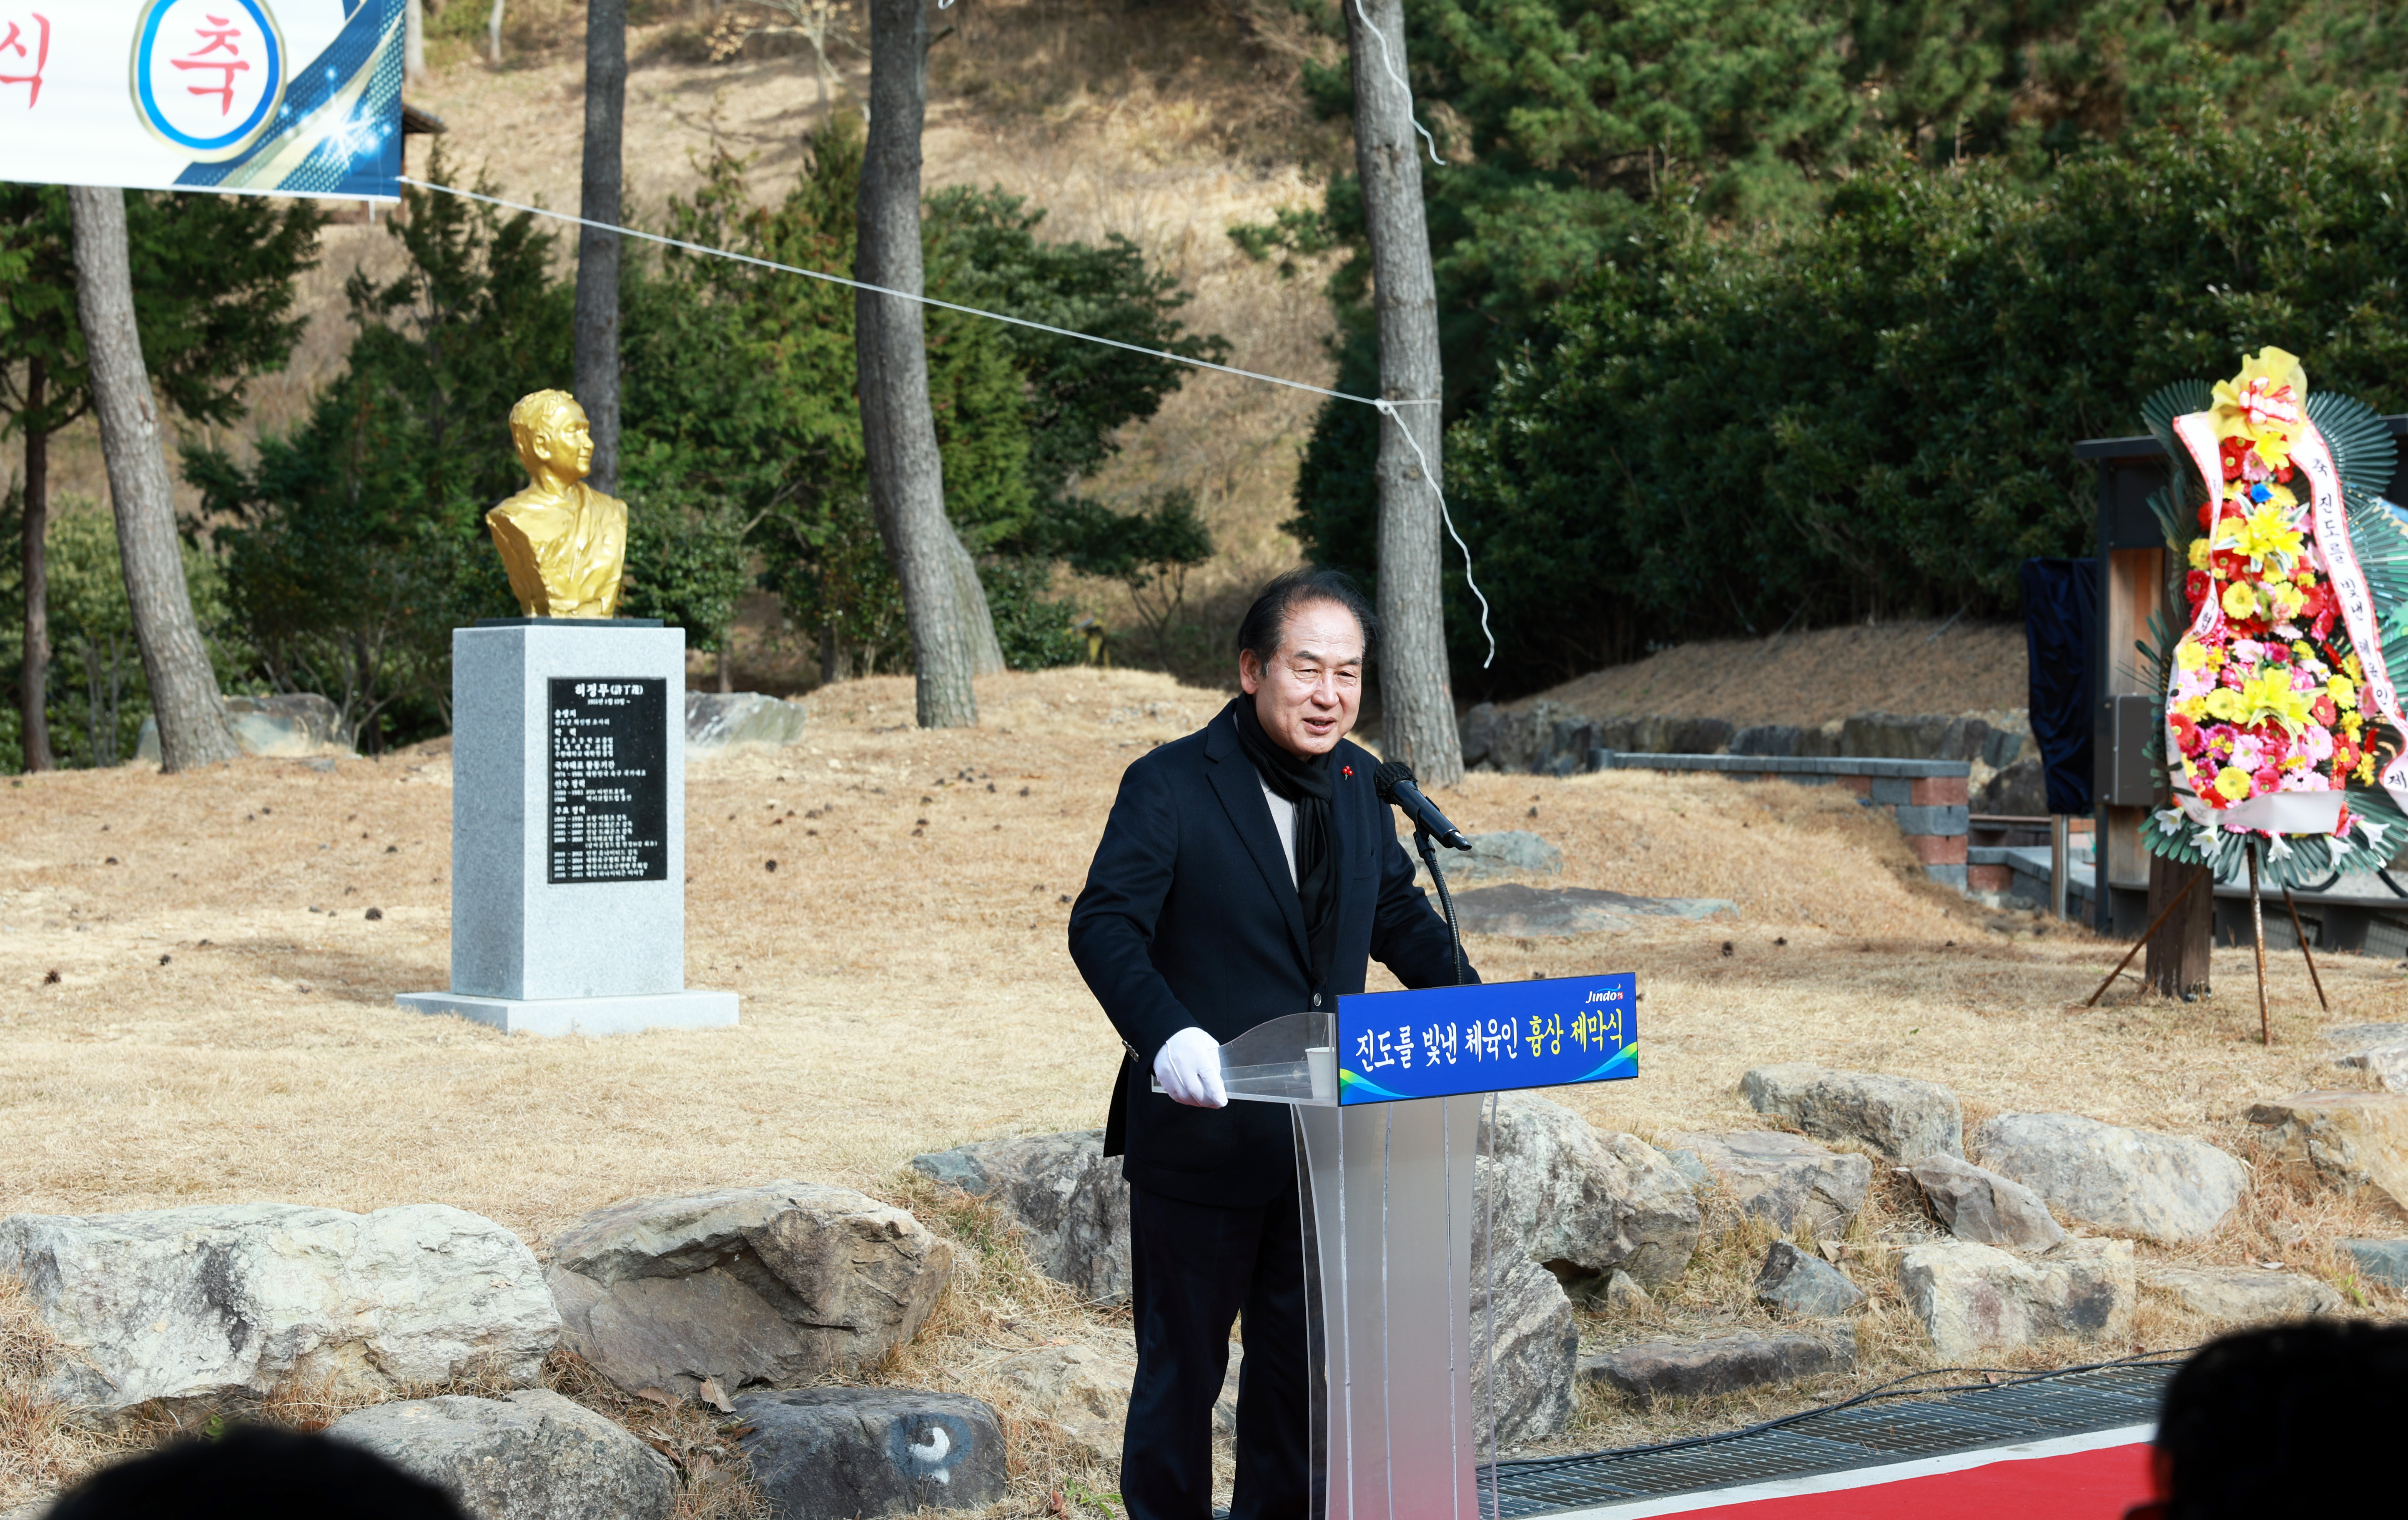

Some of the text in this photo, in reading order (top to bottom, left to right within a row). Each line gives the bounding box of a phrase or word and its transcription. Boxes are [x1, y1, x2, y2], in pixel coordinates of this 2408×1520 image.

[0, 12, 251, 117] 식 축
[2318, 493, 2345, 564] 진도를
[554, 709, 576, 718] 출생지
[554, 761, 584, 770] 국가대표
[554, 779, 585, 789] 선수 경력
[555, 805, 585, 815] 주요 경력
[1585, 991, 1617, 1004] Jindo
[1356, 1008, 1623, 1072] 진도를 빛낸 체육인 흉상 제막식
